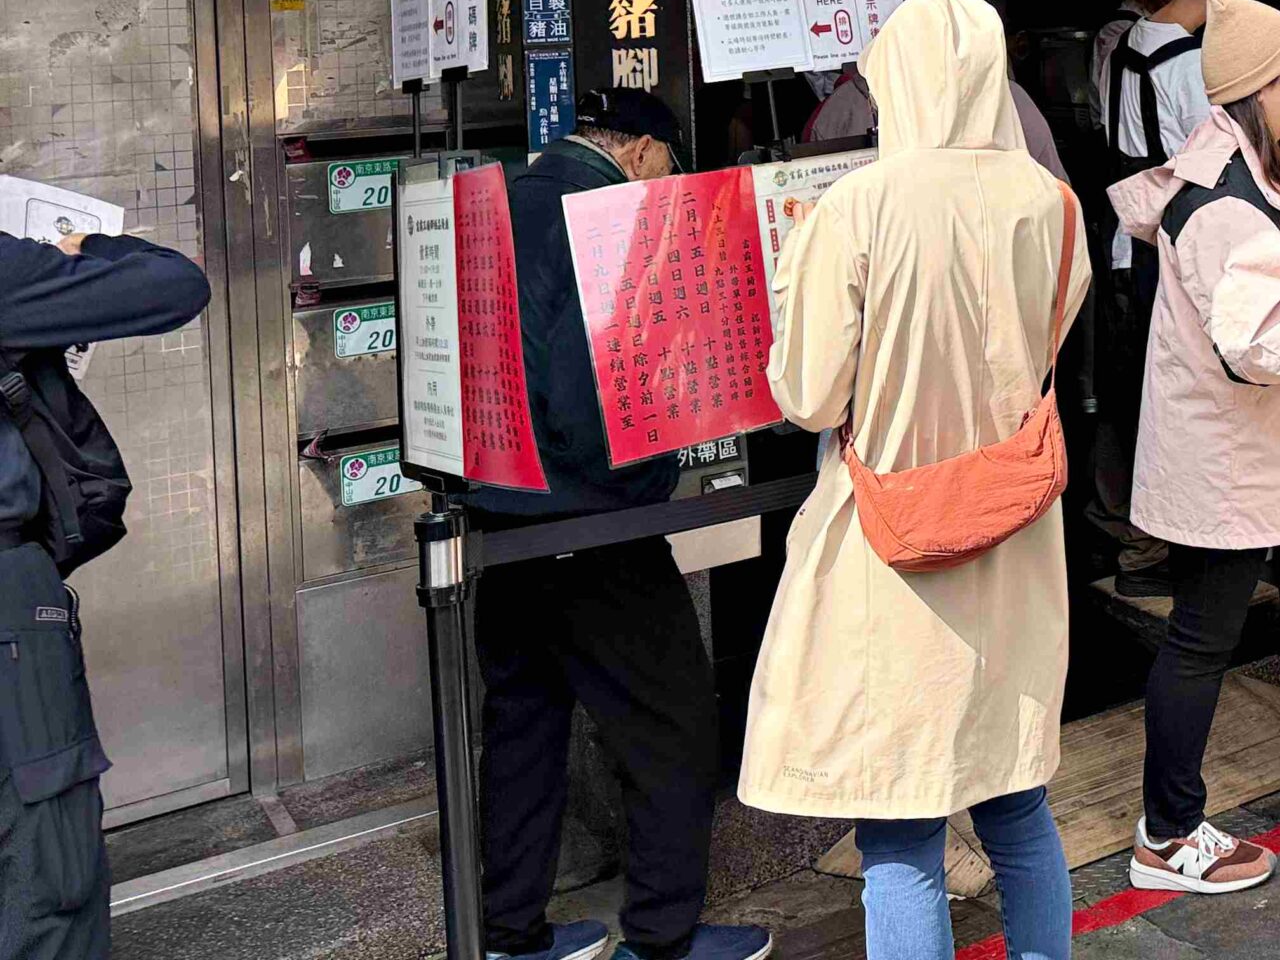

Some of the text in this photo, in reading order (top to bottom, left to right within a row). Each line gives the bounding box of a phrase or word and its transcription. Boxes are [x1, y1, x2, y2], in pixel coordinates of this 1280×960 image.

[529, 20, 567, 37] 豬油
[362, 186, 389, 206] 20
[636, 200, 680, 419] 二月十三日週五 十點營業
[658, 196, 702, 414] 二月十四日週六 十點營業
[682, 191, 723, 408] 二月十五日週日 十點營業
[367, 329, 394, 350] 20
[677, 436, 738, 467] 外帶區
[375, 474, 401, 496] 20
